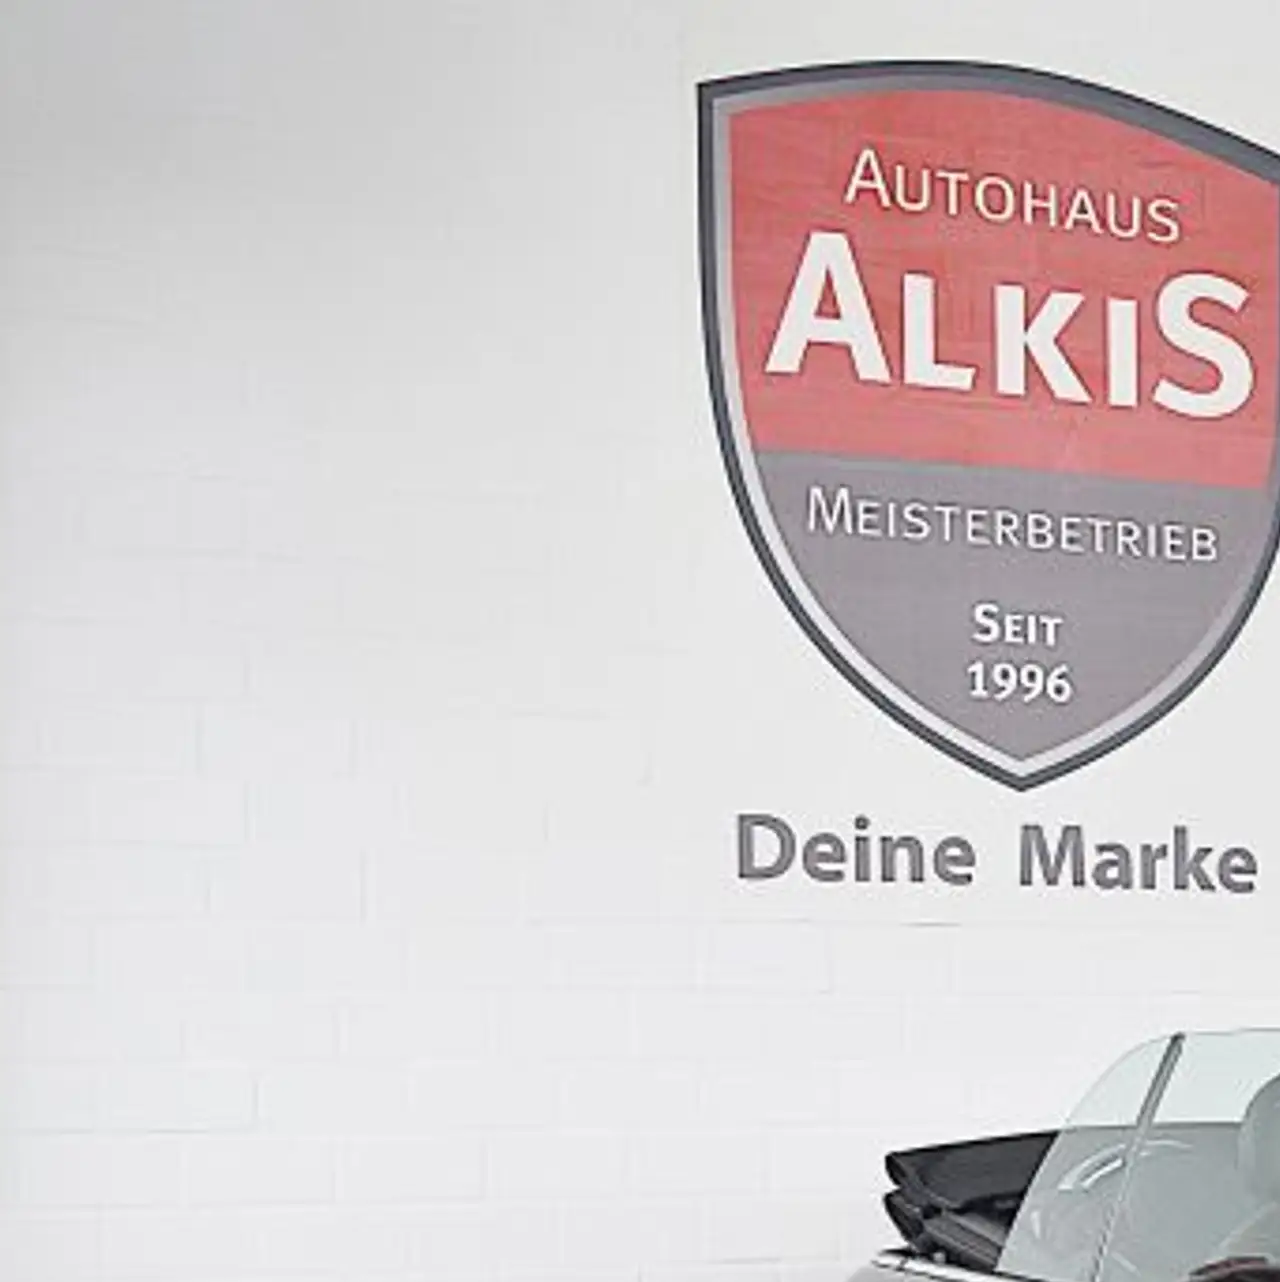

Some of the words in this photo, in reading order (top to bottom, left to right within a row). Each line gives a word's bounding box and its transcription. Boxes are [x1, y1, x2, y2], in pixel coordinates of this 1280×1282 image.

[844, 148, 1182, 243] AUTOHAUS
[764, 230, 1254, 419] ALKIS
[806, 485, 1218, 562] MEISTERBETRIEB
[971, 602, 1065, 647] SEIT
[966, 659, 1073, 703] 1996
[736, 813, 977, 885] Deine
[1018, 824, 1258, 894] Marke
